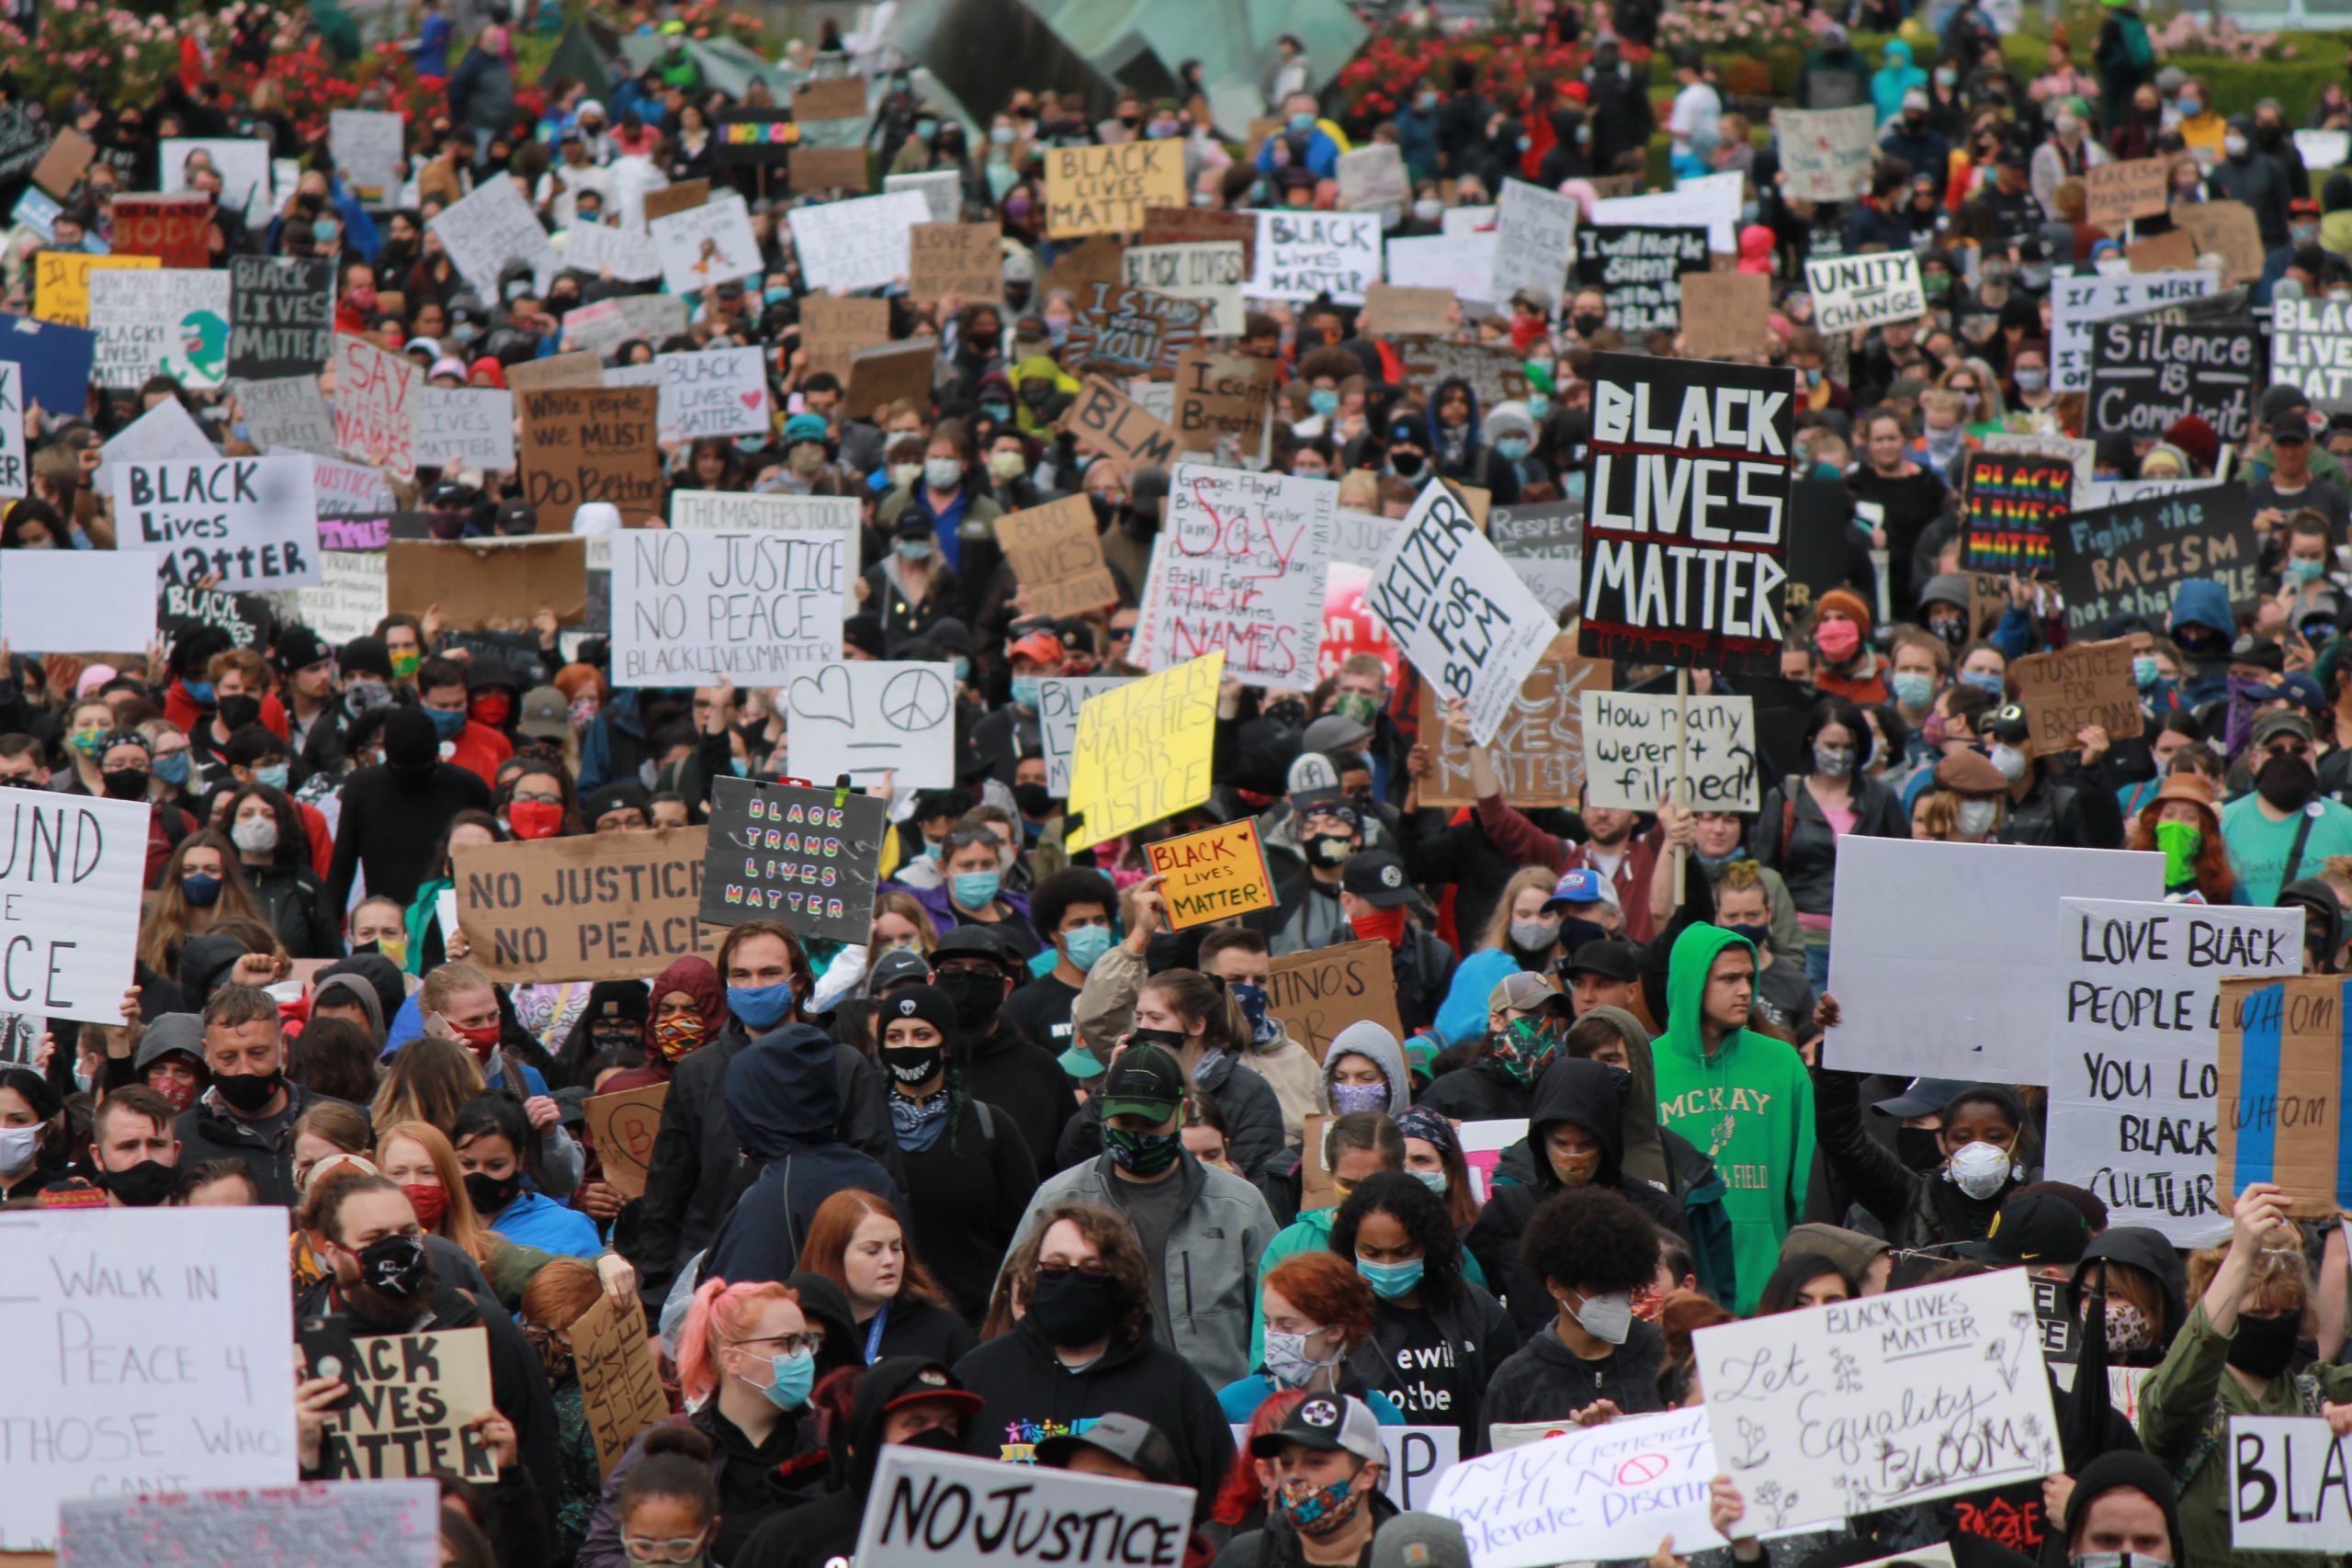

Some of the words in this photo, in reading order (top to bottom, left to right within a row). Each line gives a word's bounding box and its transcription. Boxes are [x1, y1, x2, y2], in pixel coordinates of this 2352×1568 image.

[1061, 143, 1163, 178] BLACK
[1076, 175, 1145, 197] LIVES
[114, 218, 209, 248] BODY
[1270, 215, 1372, 252] BLACK
[1579, 231, 1599, 258] I
[236, 258, 312, 289] BLACK
[1270, 270, 1366, 295] MATTER
[1811, 256, 1914, 294] UNITY
[2145, 278, 2206, 301] WERE
[237, 290, 332, 323] LIVES
[1088, 281, 1113, 314] I
[1820, 290, 1921, 330] CHANGE
[231, 326, 334, 362] MATTER
[2104, 321, 2251, 366] Silence
[345, 339, 413, 412] SAY
[666, 355, 742, 385] BLACK
[1189, 360, 1214, 396] I
[525, 390, 582, 420] White
[678, 385, 736, 409] LIVES
[1592, 378, 1790, 457] BLACK
[580, 421, 651, 447] MUST
[675, 408, 749, 434] MATTER
[1080, 386, 1178, 467] BLM
[334, 409, 413, 477] NAMES
[130, 460, 260, 507] BLACK
[528, 468, 574, 505] Do
[578, 464, 663, 504] Better
[1239, 473, 1283, 502] Floyd
[1589, 453, 1786, 545] LIVES
[1973, 463, 2071, 503] BLACK
[140, 512, 230, 543] Lives
[2069, 514, 2147, 558] Fight
[2158, 501, 2204, 530] the
[634, 531, 690, 589] NO
[707, 533, 845, 595] JUSTICE
[1968, 531, 2056, 571] MATTE
[2090, 532, 2240, 595] RACISM
[1370, 494, 1476, 650] KEIZER
[1583, 538, 1788, 641] MATTER
[166, 584, 242, 618] BLACK
[634, 593, 687, 642] NO
[707, 592, 820, 642] PEACE
[1427, 574, 1483, 656] FOR
[2069, 597, 2110, 630] not
[2119, 585, 2170, 618] the
[1171, 615, 1297, 674] NAMES
[1443, 595, 1513, 700] BLM
[2031, 647, 2120, 684] JUSTICE
[1596, 695, 1651, 728] How
[2062, 678, 2097, 705] FOR
[1073, 683, 1218, 775] MARCHES
[1103, 739, 1172, 795] FOR
[748, 797, 844, 829] BLACK
[745, 826, 841, 859] TRANS
[1152, 834, 1238, 873] BLACK
[467, 871, 523, 910] NO
[743, 856, 839, 887] LIVES
[1182, 864, 1236, 887] LIVES
[724, 883, 844, 919] MATTER
[1171, 874, 1268, 920] MATTER!
[493, 924, 549, 965] NO
[578, 916, 718, 963] PEACE
[2081, 914, 2170, 966] LOVE
[2188, 919, 2288, 969] BLACK
[1267, 960, 1365, 1010] TINOS
[2067, 979, 2197, 1032] PEOPLE
[2233, 993, 2335, 1035] WHOM
[2084, 1051, 2153, 1101] YOU
[2178, 1058, 2219, 1100] LO
[1659, 1087, 1771, 1127] MCKAY
[2228, 1094, 2329, 1134] WHOM
[2120, 1113, 2219, 1157] BLACK
[1733, 1164, 1768, 1190] FIELD
[2088, 1166, 2221, 1217] CULTUR
[49, 1249, 163, 1301] WALK
[185, 1265, 220, 1301] IN
[1826, 1303, 1903, 1335] BLACK
[1904, 1292, 1970, 1324] LIVES
[1881, 1316, 1981, 1355] MATTER
[56, 1308, 198, 1387] PEACE
[225, 1345, 254, 1405] 4
[350, 1336, 440, 1383] ACK
[594, 1308, 635, 1427] LIVES
[1713, 1342, 1810, 1405] Let
[581, 1340, 621, 1459] BLACK
[1419, 1380, 1453, 1412] be
[1, 1413, 167, 1464] THOSE
[190, 1416, 281, 1457] WHO
[1795, 1381, 1999, 1468] Equality
[330, 1424, 496, 1479] ATTER
[1877, 1416, 2030, 1490] BLOOM
[879, 1472, 974, 1556] NO
[973, 1482, 1182, 1564] JUSTICE
